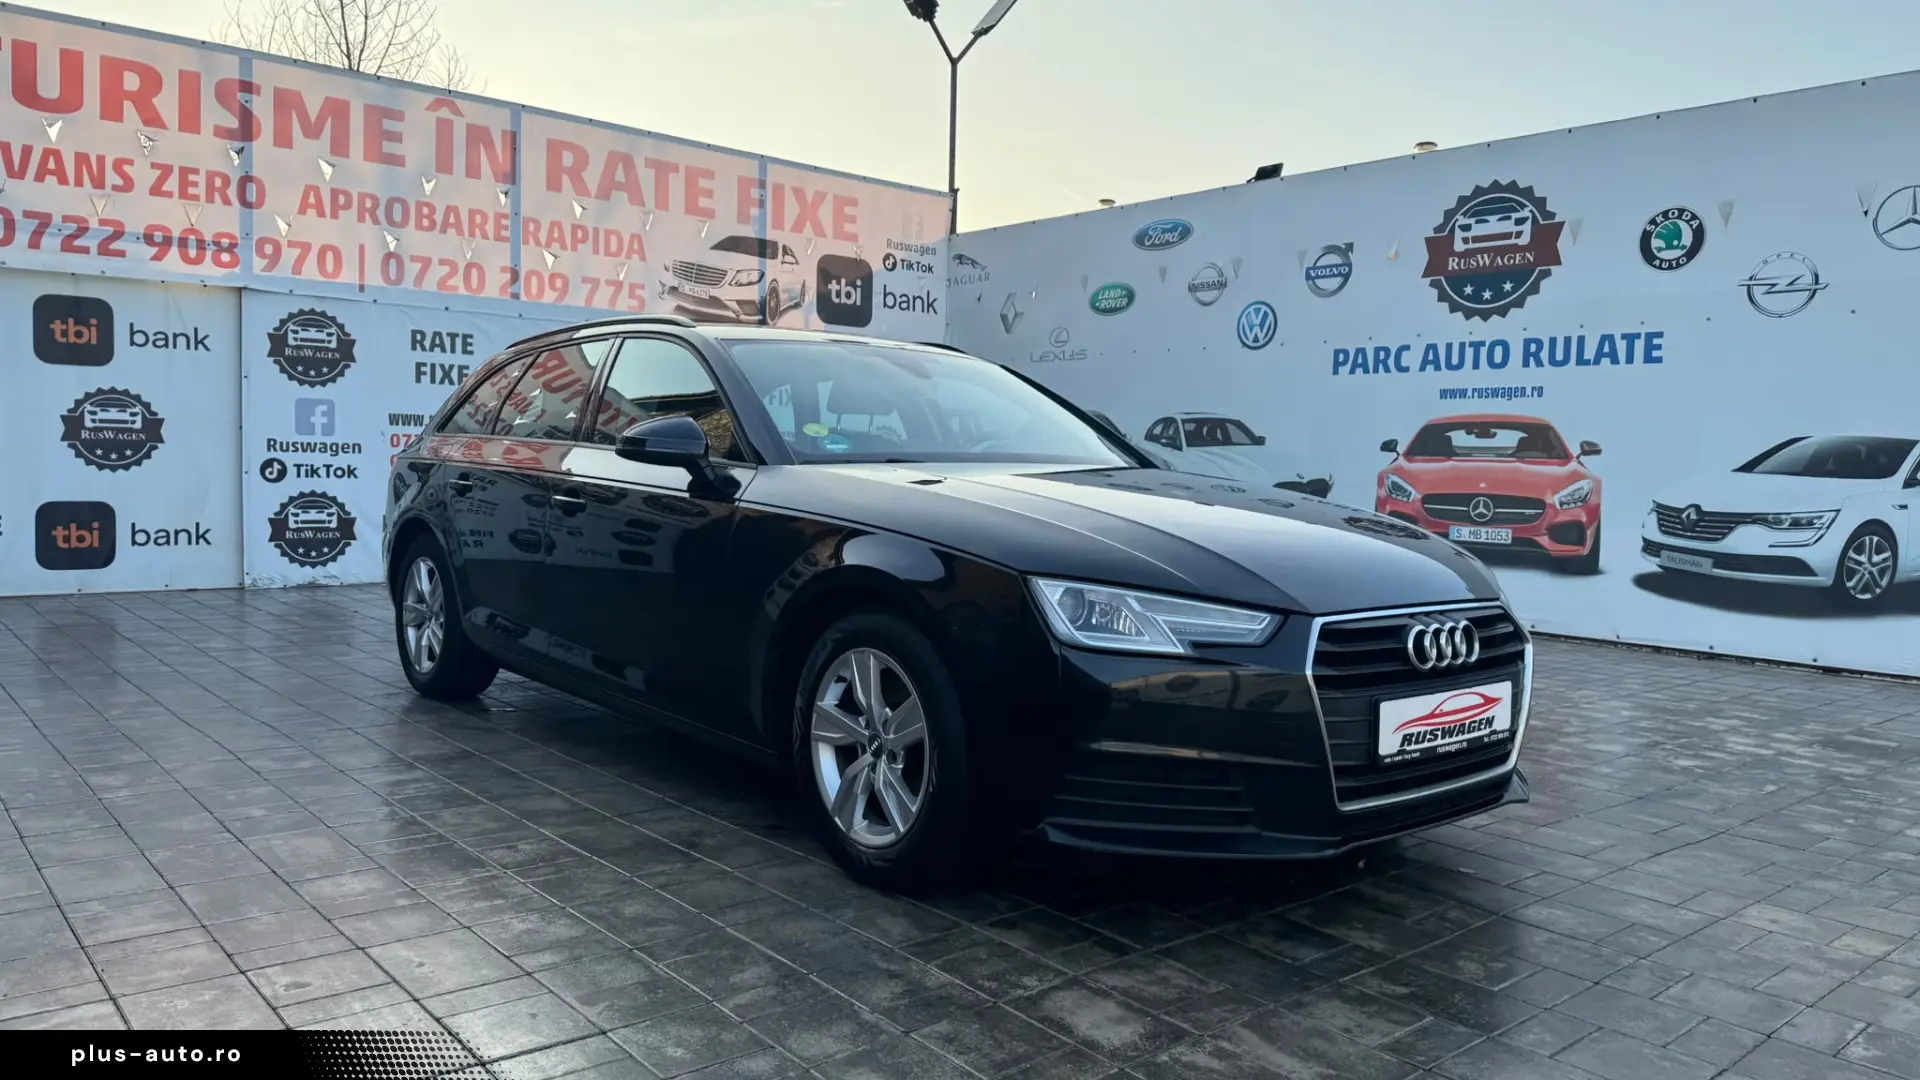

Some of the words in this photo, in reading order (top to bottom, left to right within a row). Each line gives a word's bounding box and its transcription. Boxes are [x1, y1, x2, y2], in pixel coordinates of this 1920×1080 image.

[0, 36, 406, 168] URISME
[424, 97, 517, 185] ÎN
[545, 138, 716, 220] RATE
[737, 175, 860, 244] FIXE
[149, 161, 266, 210] ZERO
[297, 183, 511, 244] APROBARE
[522, 216, 647, 262] RAPIDA
[1645, 209, 1700, 233] SKODA
[1144, 223, 1180, 246] Ford
[886, 238, 937, 257] Ruswagen
[900, 258, 934, 275] TikTok
[1652, 256, 1688, 269] AUTO
[1762, 252, 1808, 265] OPEL
[142, 223, 241, 270] 908
[254, 236, 343, 280] 970
[380, 251, 486, 296] 0720
[499, 266, 570, 305] 209
[580, 276, 646, 313] 775
[1309, 265, 1349, 277] VOLVO
[945, 272, 990, 289] JAGUAR
[1191, 279, 1224, 291] NISSAN
[828, 278, 862, 307] tbi
[882, 284, 938, 316] bank
[1098, 288, 1121, 300] LAND
[1098, 298, 1128, 309] ROVER
[49, 317, 98, 345] tbi
[129, 322, 211, 352] bank
[410, 329, 475, 355] RATE
[1030, 349, 1088, 363] LEXUS
[1332, 344, 1411, 375] PARC
[1418, 338, 1510, 372] AUTO
[1521, 331, 1664, 369] RULATE
[1439, 385, 1544, 401] www.ruswagen.ro
[266, 438, 362, 457] Ruswagen
[293, 463, 359, 479] TikTok
[52, 521, 100, 549] tbi
[131, 521, 212, 547] bank
[1468, 529, 1482, 540] MB
[1484, 530, 1510, 542] 1053
[1666, 555, 1704, 569] TALISMAN
[1399, 715, 1496, 748] RUSWAGEN
